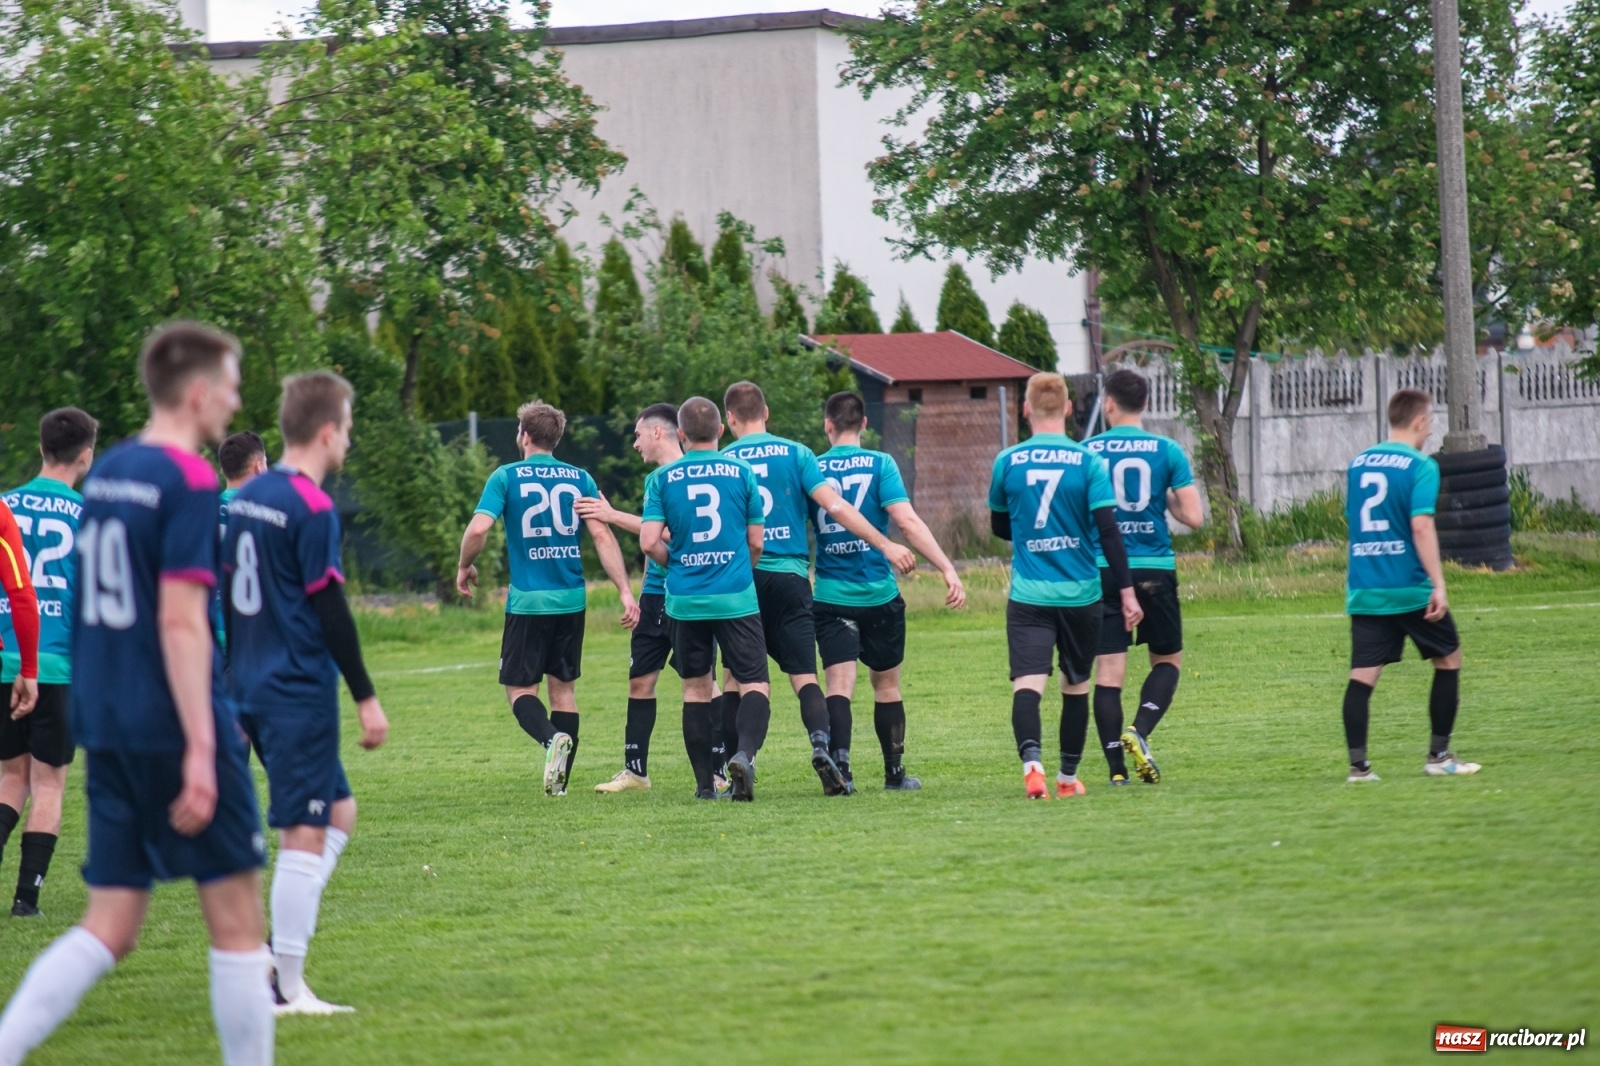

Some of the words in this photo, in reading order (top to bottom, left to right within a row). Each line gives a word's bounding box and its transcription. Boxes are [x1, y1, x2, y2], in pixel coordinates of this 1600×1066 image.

[739, 445, 789, 460] CZARNI
[1010, 450, 1029, 466] KS
[1031, 449, 1083, 466] CZARNI
[1106, 440, 1158, 453] CZARNI
[516, 466, 534, 478] KS
[535, 467, 580, 479] CZARNI
[667, 467, 685, 483] KS
[687, 463, 740, 478] CZARNI
[829, 456, 874, 471] CZARNI
[1364, 453, 1413, 470] CZARNI
[1102, 457, 1152, 512] 0
[22, 494, 83, 520] CZARNI
[520, 482, 582, 538] 20
[817, 473, 873, 534] 27
[1026, 469, 1065, 529] 7
[1360, 471, 1390, 532] 2
[687, 483, 722, 543] 3
[825, 539, 870, 555] GORZYE
[76, 517, 137, 629] 19
[231, 530, 262, 616] 8
